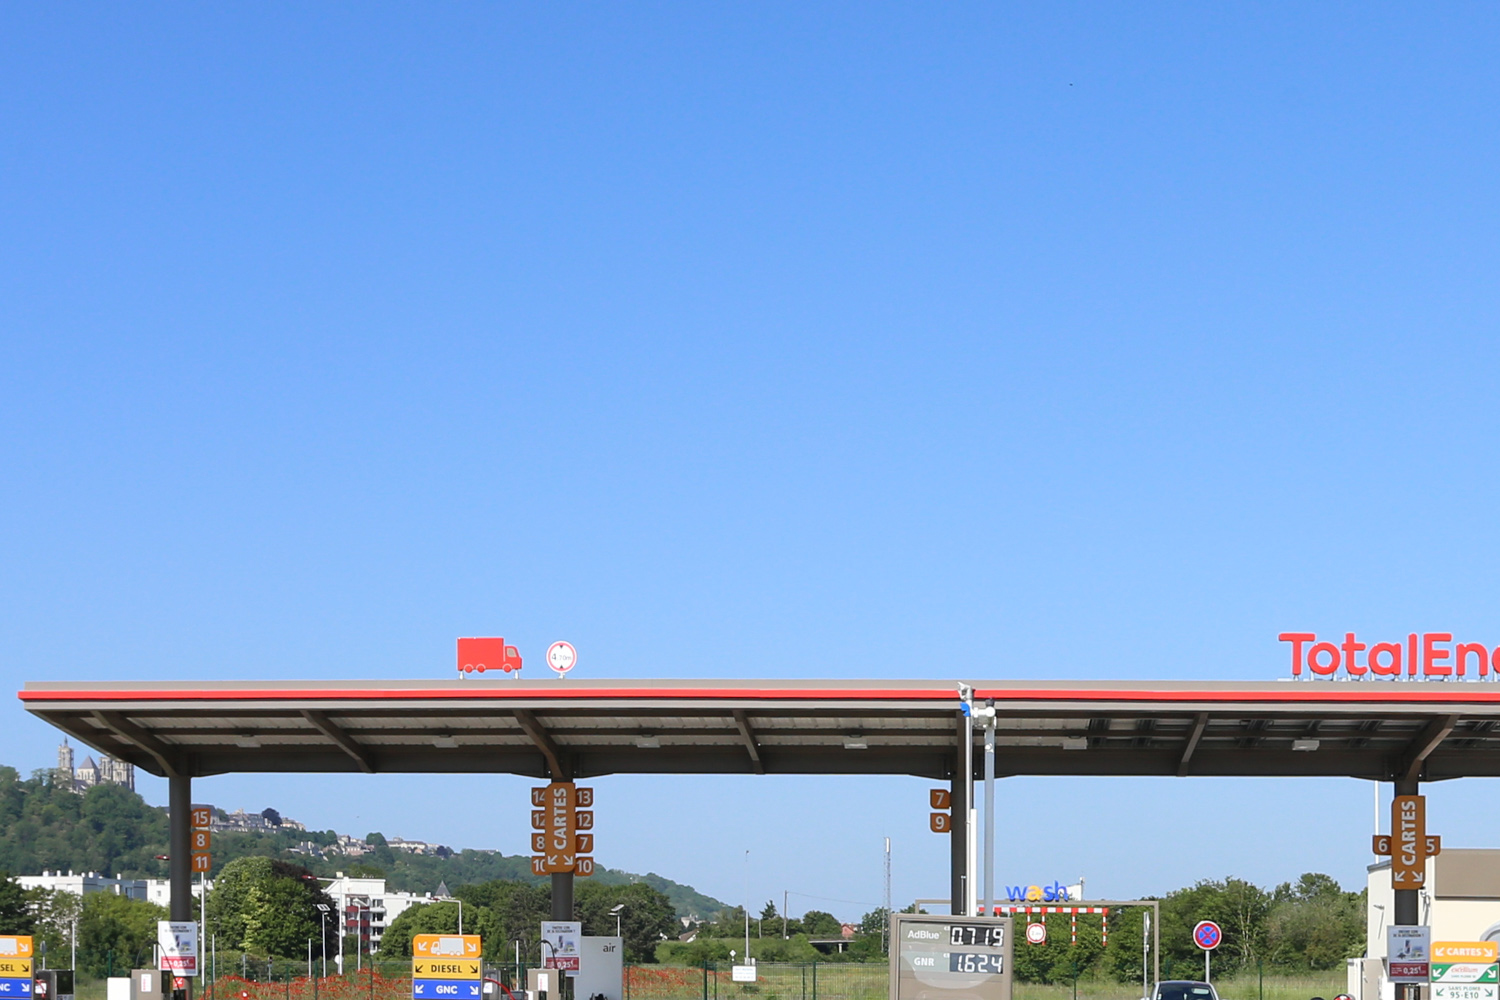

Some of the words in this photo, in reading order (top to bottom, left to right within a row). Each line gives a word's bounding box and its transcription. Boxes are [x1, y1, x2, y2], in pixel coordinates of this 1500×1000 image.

[577, 790, 591, 804] 13
[935, 792, 945, 806] 7
[193, 811, 208, 825] 15
[553, 787, 567, 850] CARTES
[577, 813, 592, 827] 12
[935, 815, 945, 830] 9
[196, 833, 206, 847] 8
[1401, 800, 1416, 866] CARTES
[536, 836, 545, 850] 8
[580, 837, 588, 851] 7
[1378, 838, 1388, 853] 6
[1426, 838, 1436, 853] 5
[195, 856, 208, 869] 11
[577, 859, 592, 873] 10
[1005, 880, 1069, 902] wash
[907, 930, 940, 940] AdBlue
[951, 927, 1004, 947] 0.719
[602, 942, 617, 953] air
[1446, 947, 1482, 957] CARTES
[431, 964, 462, 973] DIESEL
[913, 957, 935, 967] GNR
[435, 985, 458, 994] GNC
